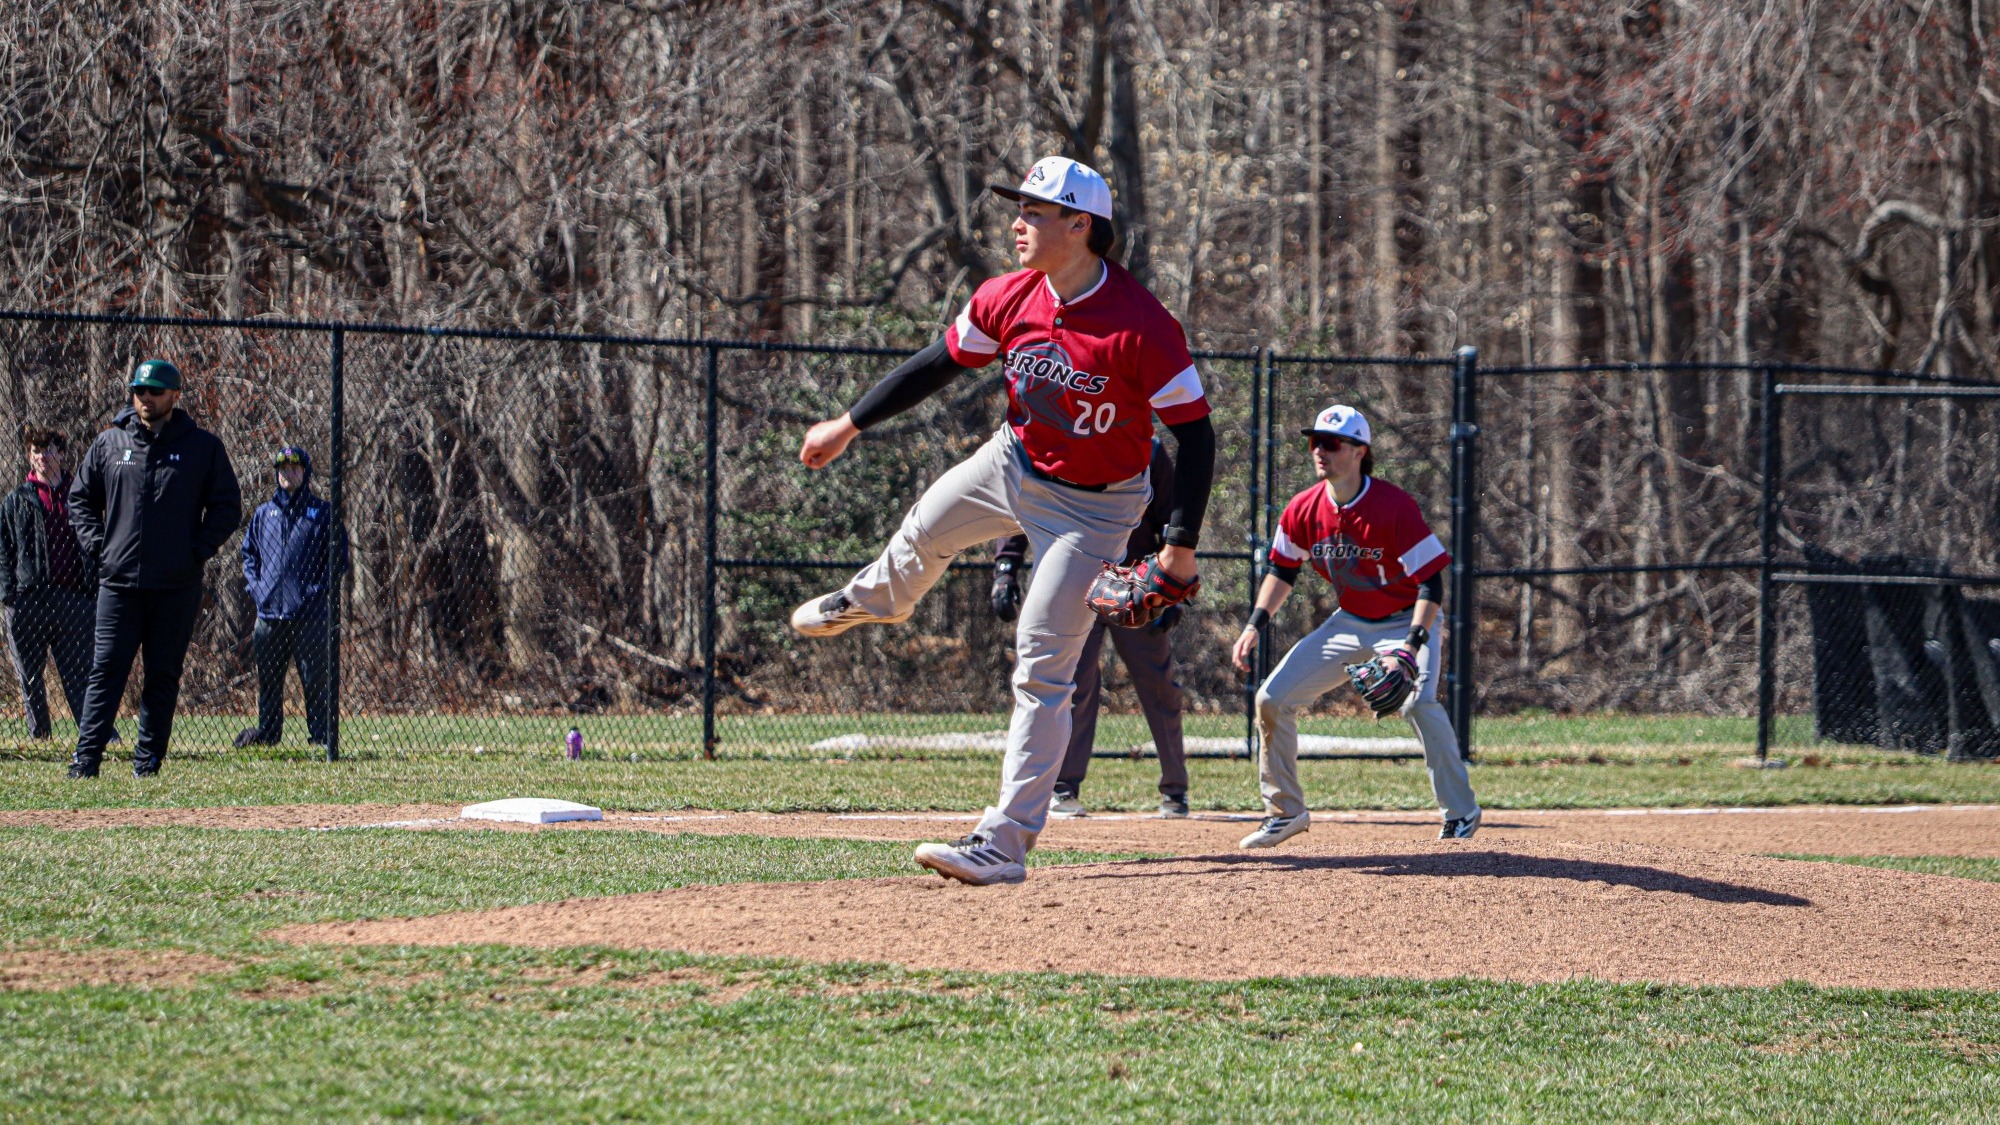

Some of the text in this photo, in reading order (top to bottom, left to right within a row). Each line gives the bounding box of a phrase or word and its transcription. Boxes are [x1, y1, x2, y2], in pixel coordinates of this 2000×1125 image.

[1005, 350, 1109, 394] BRONCS
[1073, 399, 1117, 435] 20
[1312, 543, 1384, 561] BRONCS
[1377, 564, 1388, 586] 1
